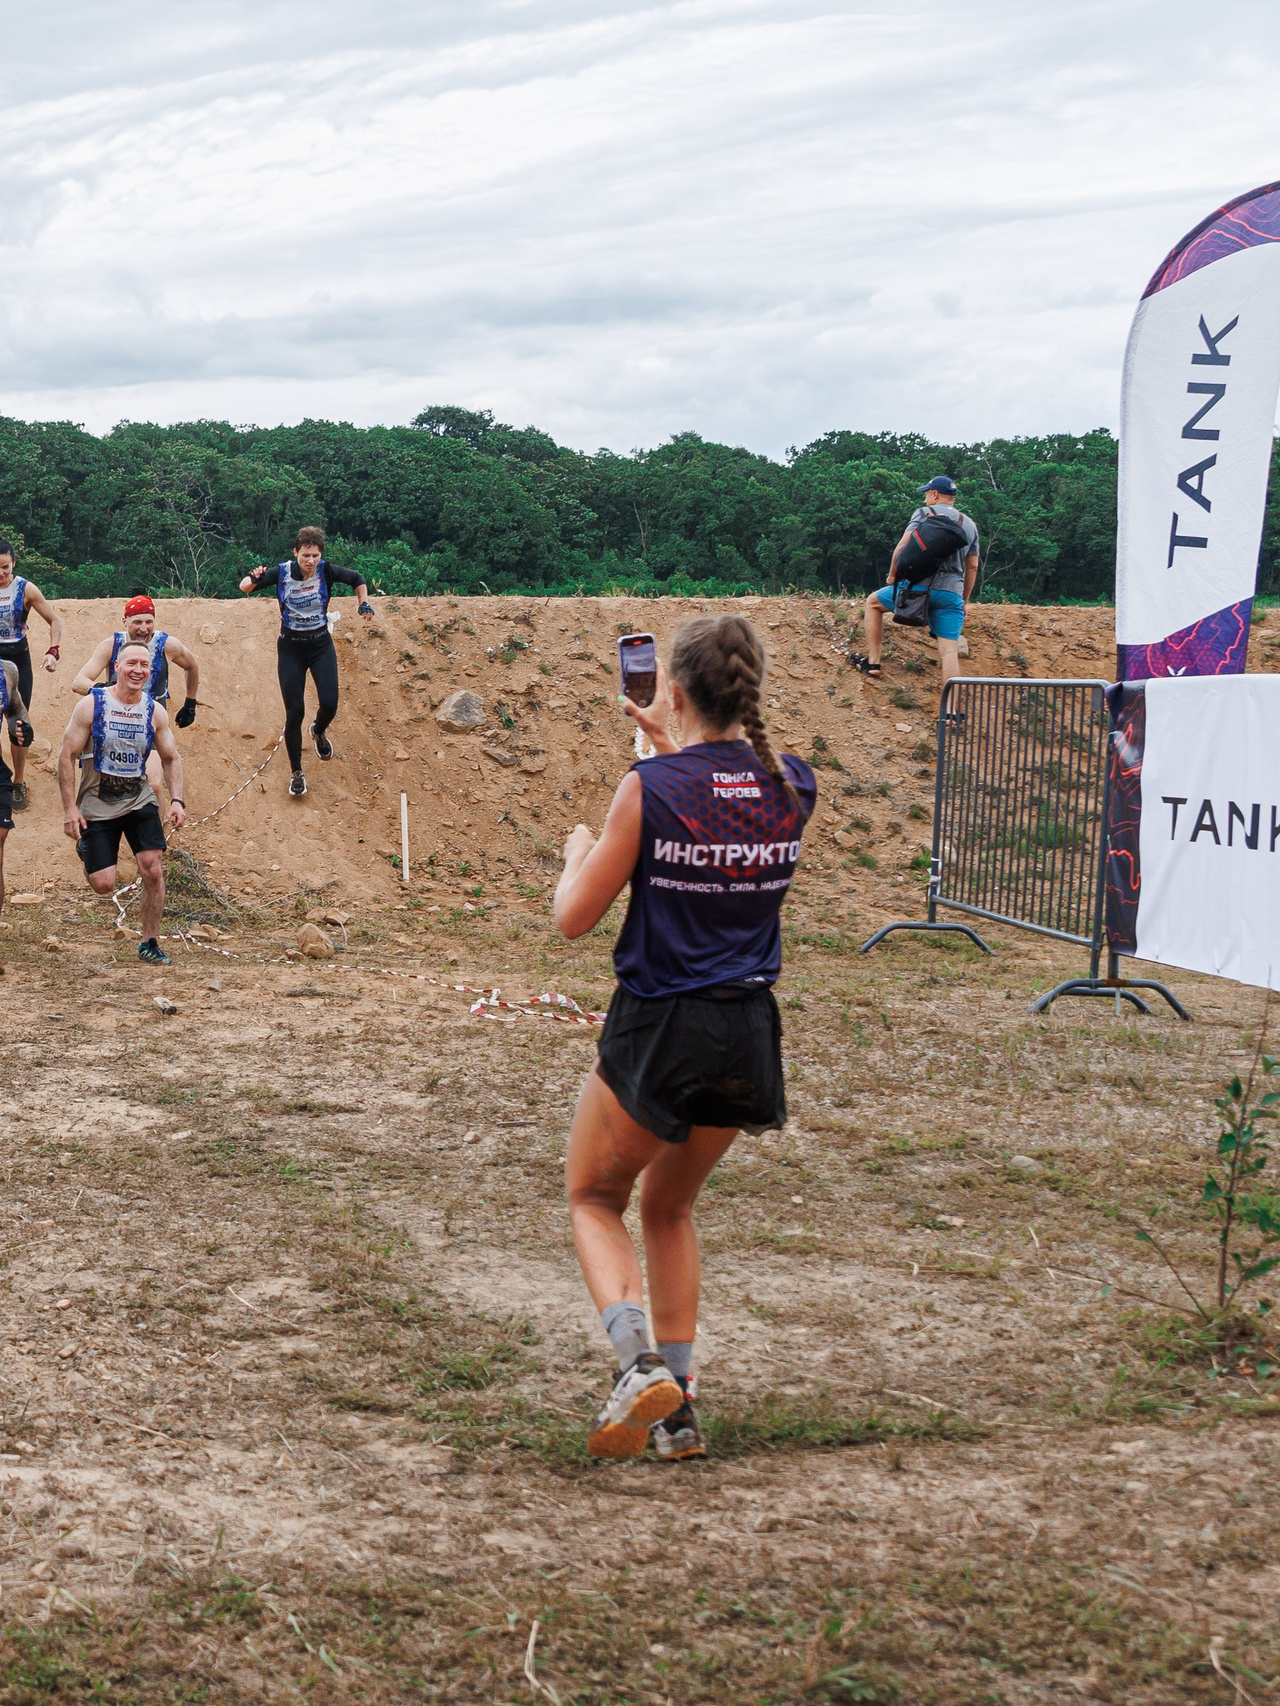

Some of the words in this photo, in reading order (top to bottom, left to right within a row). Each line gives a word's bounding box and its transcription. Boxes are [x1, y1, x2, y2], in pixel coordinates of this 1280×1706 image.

[1167, 313, 1239, 569] TANK
[110, 751, 139, 763] 04908
[712, 772, 756, 783] ГОНКА
[712, 787, 762, 798] ГЕРОЕВ
[653, 839, 801, 867] ИНСТРУКТО
